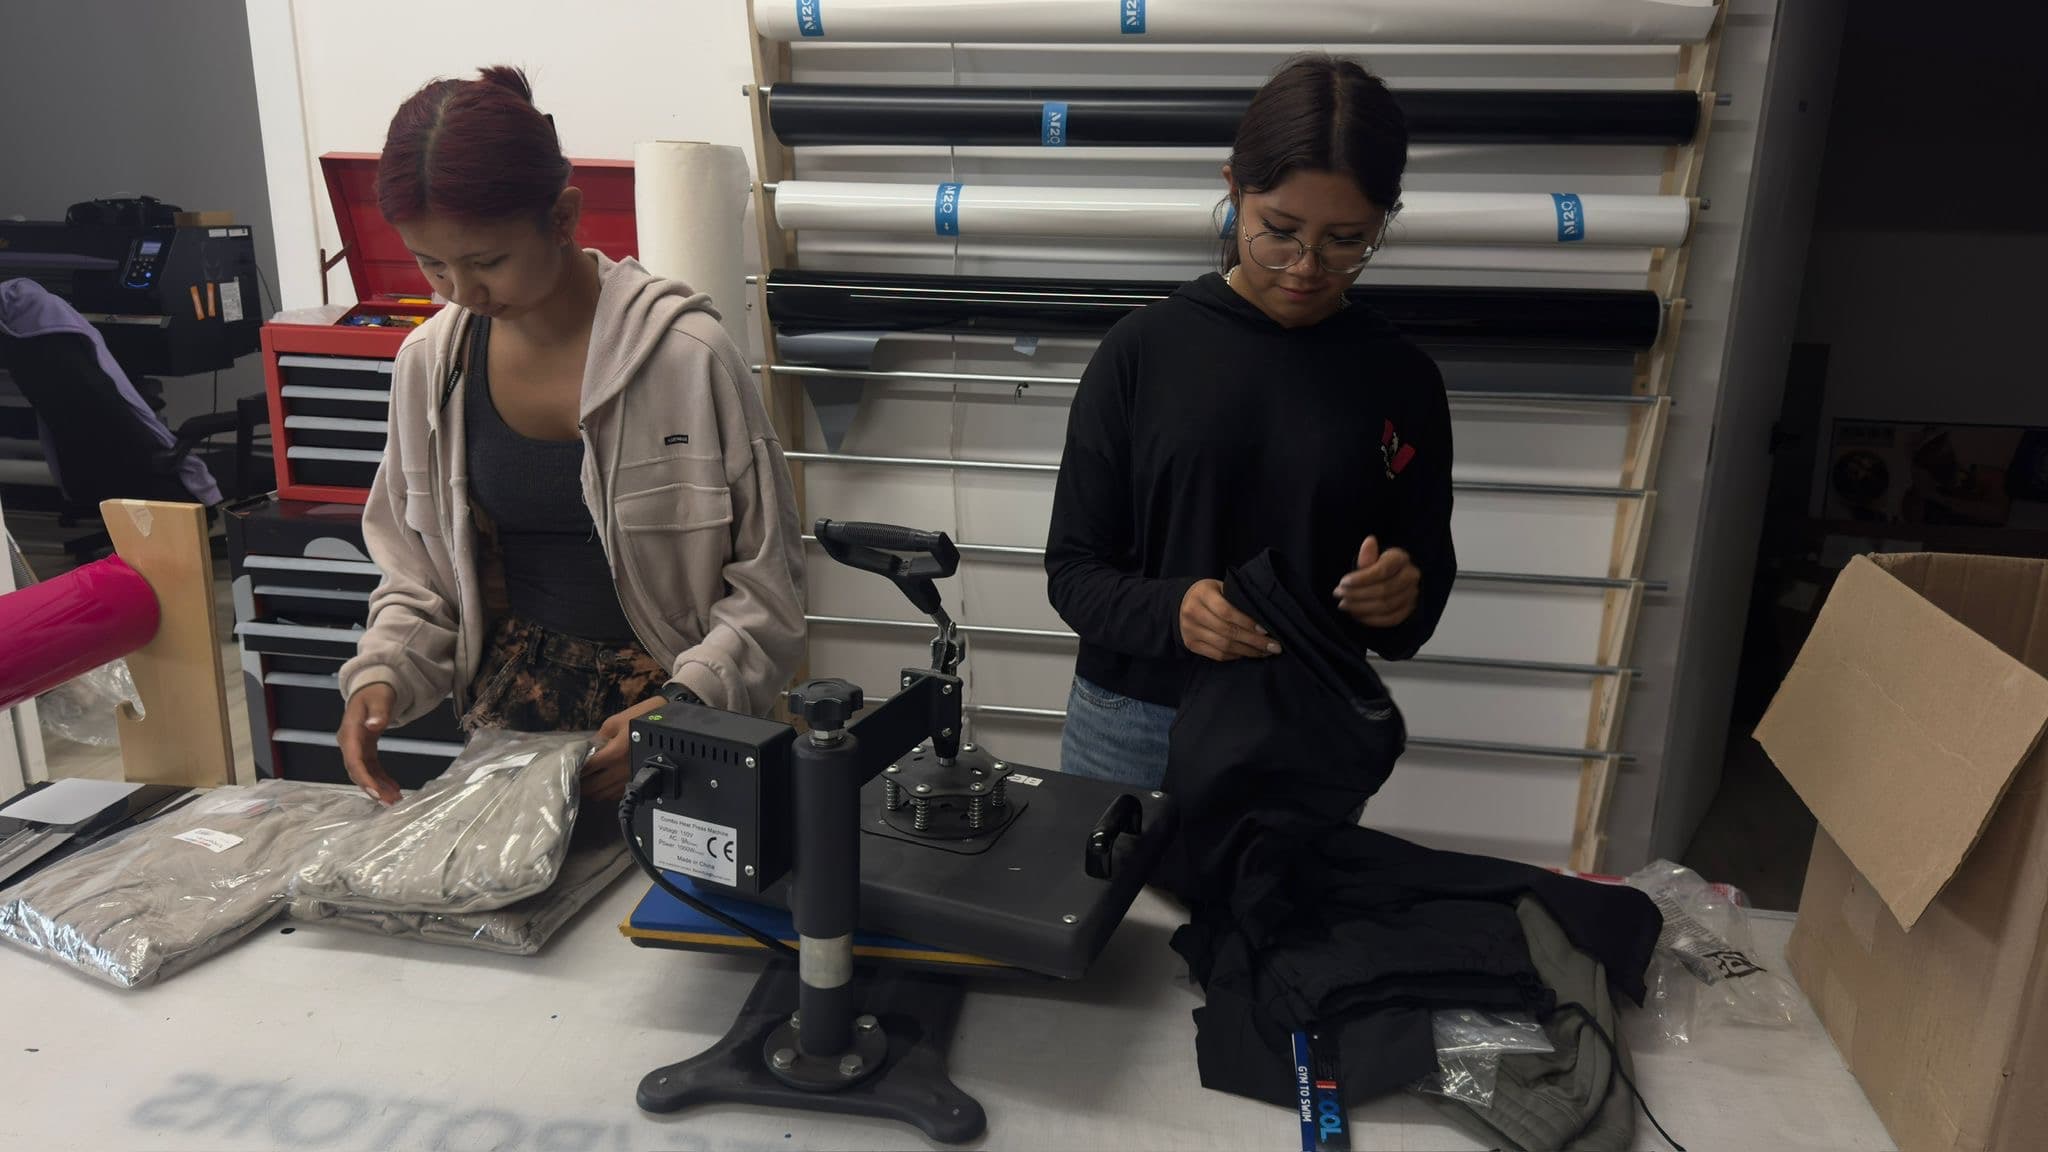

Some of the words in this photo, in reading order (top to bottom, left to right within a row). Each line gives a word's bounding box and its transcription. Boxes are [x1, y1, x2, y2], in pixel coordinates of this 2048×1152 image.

[660, 815, 679, 825] Combo
[679, 820, 691, 828] Heat
[692, 823, 707, 832] Press
[707, 828, 729, 837] Machine
[677, 855, 692, 863] Made
[699, 860, 715, 870] China
[1298, 1066, 1309, 1084] GYM
[1299, 1085, 1310, 1097] TO
[1301, 1099, 1312, 1122] SWIM
